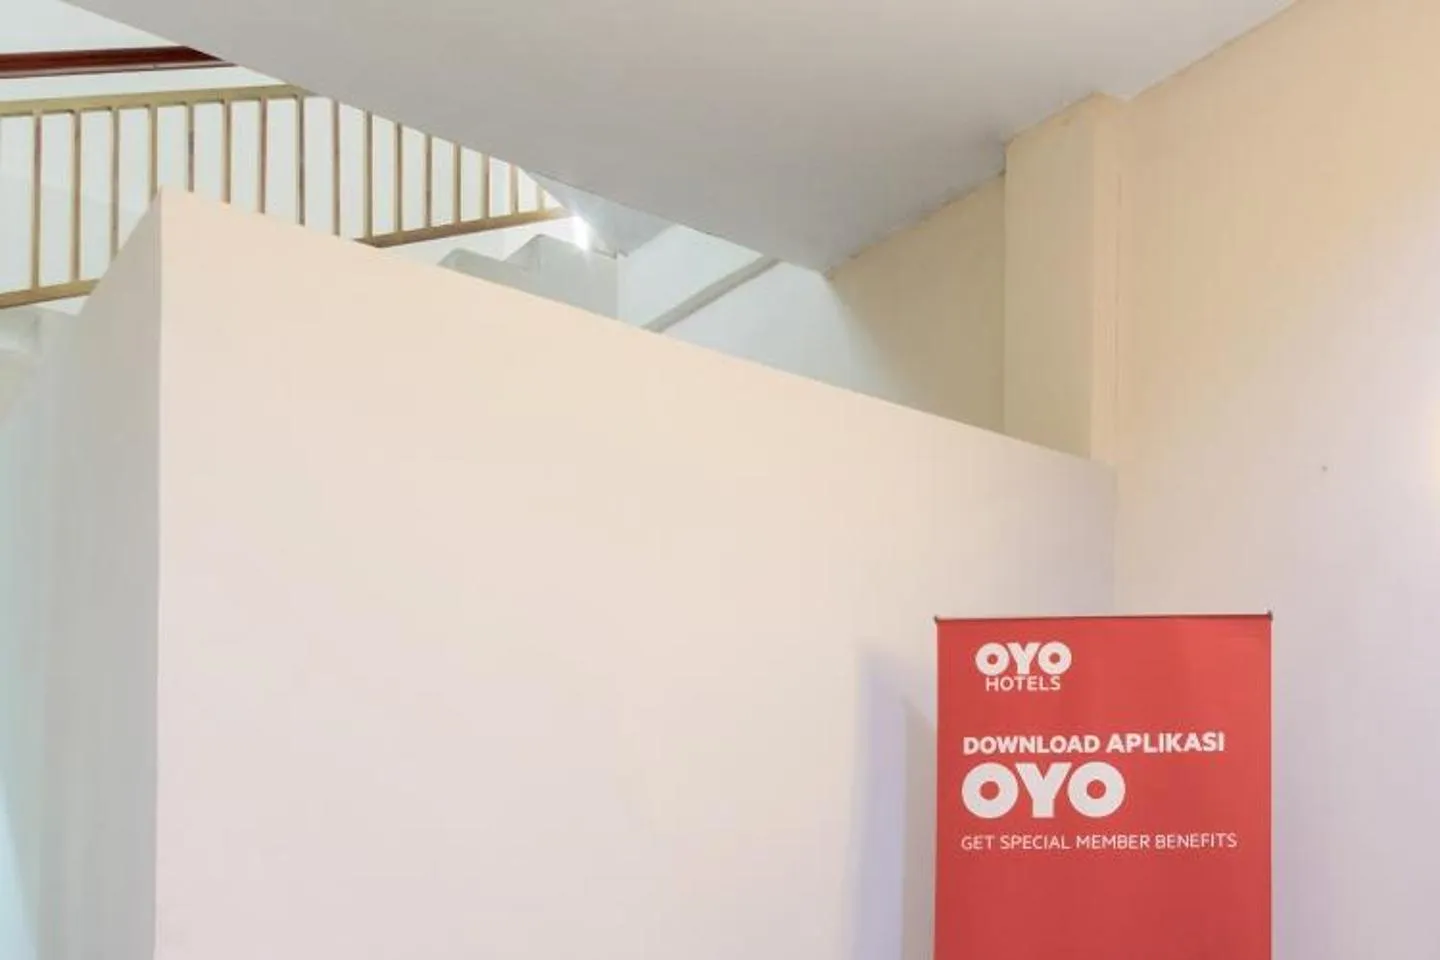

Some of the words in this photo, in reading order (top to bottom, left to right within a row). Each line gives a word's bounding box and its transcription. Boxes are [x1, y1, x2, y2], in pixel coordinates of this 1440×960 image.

[975, 641, 1072, 676] OYO
[986, 676, 1061, 692] HOTELS
[963, 735, 1100, 755] DOWNLOAD
[1105, 731, 1225, 753] APLIKASI
[961, 761, 1126, 818] OYO
[961, 835, 995, 850] GET
[1000, 834, 1070, 850] SPECIAL
[1076, 834, 1150, 849] MEMBER
[1155, 832, 1238, 849] BENEFITS
